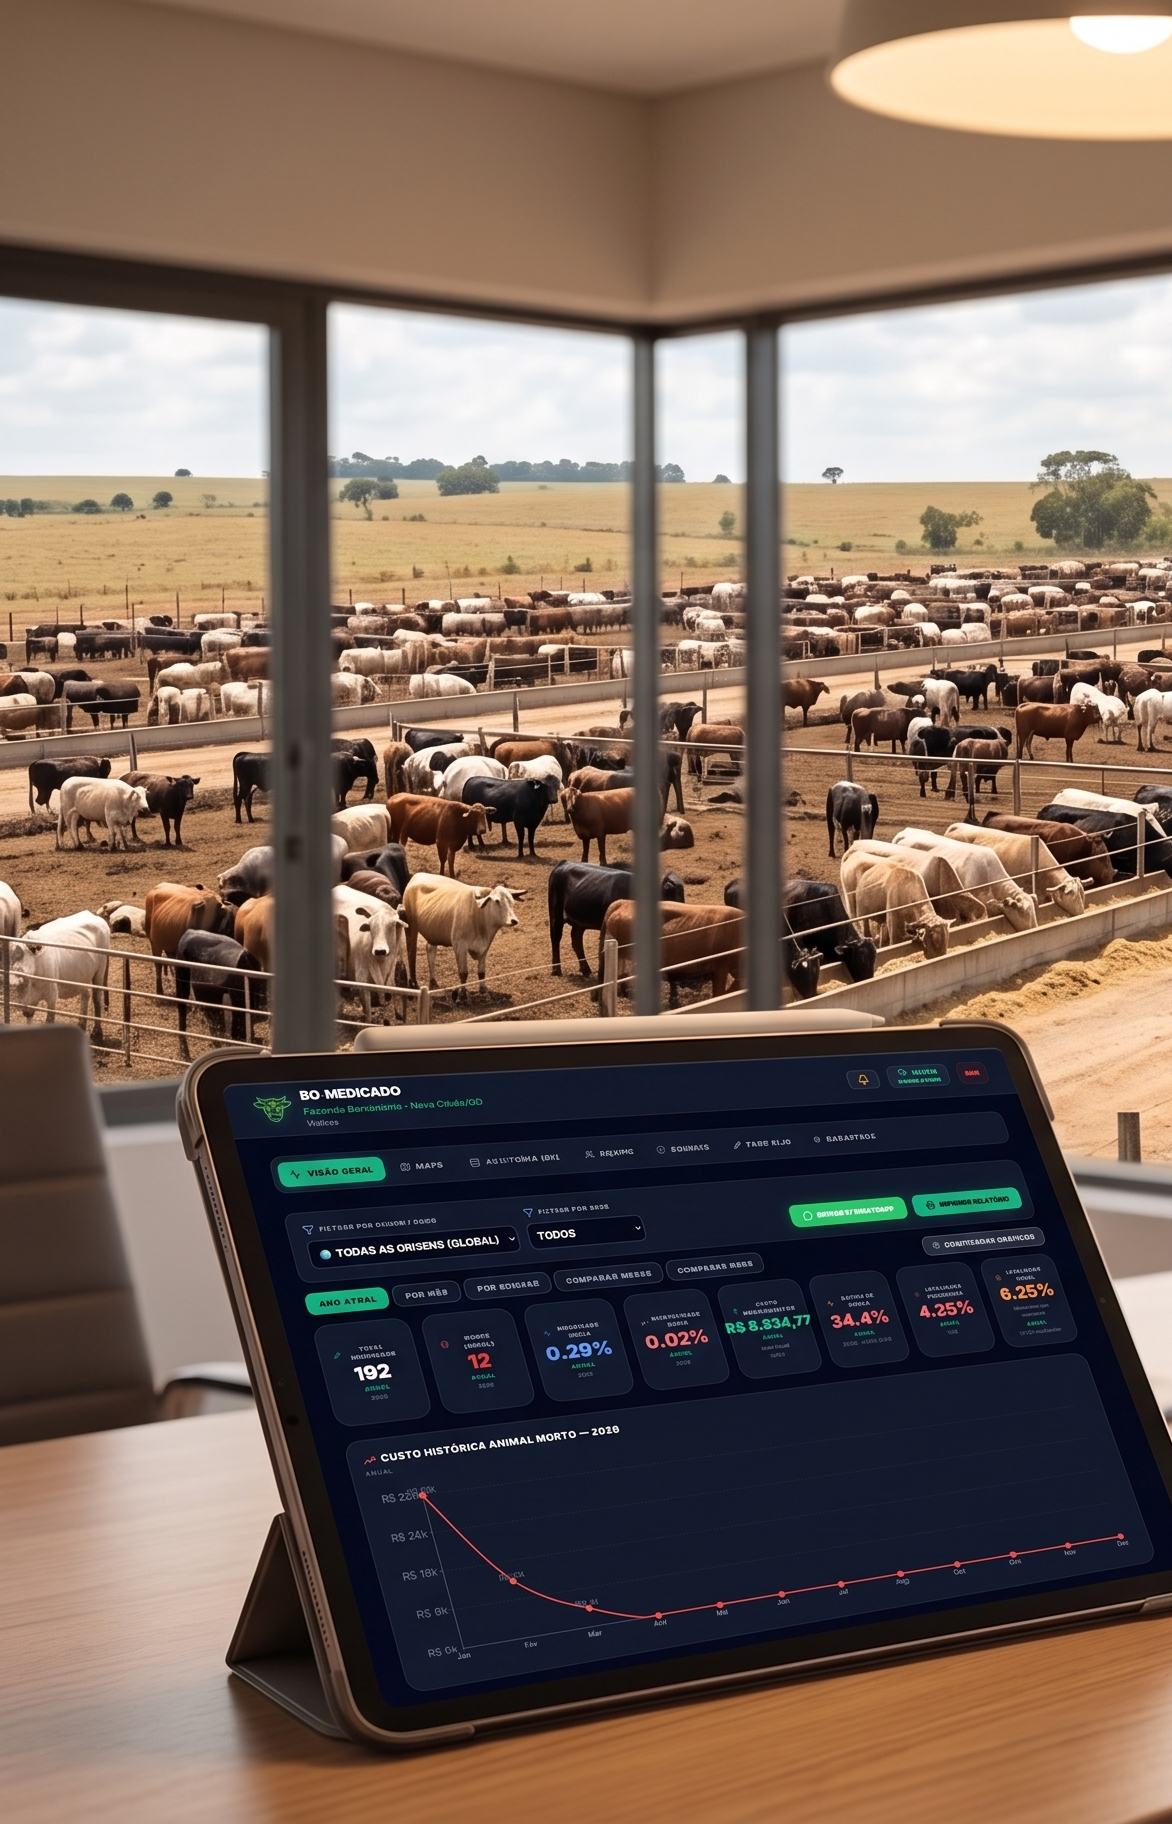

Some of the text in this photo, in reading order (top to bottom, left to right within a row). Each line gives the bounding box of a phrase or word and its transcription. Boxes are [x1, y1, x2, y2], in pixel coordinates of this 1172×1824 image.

[323, 1086, 402, 1100] MEDICADO
[307, 1165, 374, 1178] VISÃO GERAL
[415, 1161, 443, 1170] MAPS
[536, 1229, 577, 1241] TODOS
[335, 1245, 377, 1258] TODAS
[379, 1244, 395, 1255] AS
[447, 1235, 500, 1250] (GLOBAL)
[405, 1290, 425, 1300] POR
[476, 1283, 498, 1293] POR
[1000, 1282, 1054, 1301] 6.25%
[319, 1297, 342, 1308] ANO
[919, 1299, 974, 1318] 4.25%
[645, 1328, 709, 1349] 0.02%
[545, 1340, 613, 1361] 0.29%
[467, 1352, 492, 1369] 12
[353, 1363, 392, 1381] 192
[380, 1449, 422, 1463] CUSTO
[424, 1442, 487, 1457] HISTÓRICA
[489, 1435, 534, 1449] ANIMAL
[535, 1429, 577, 1443] MORTO
